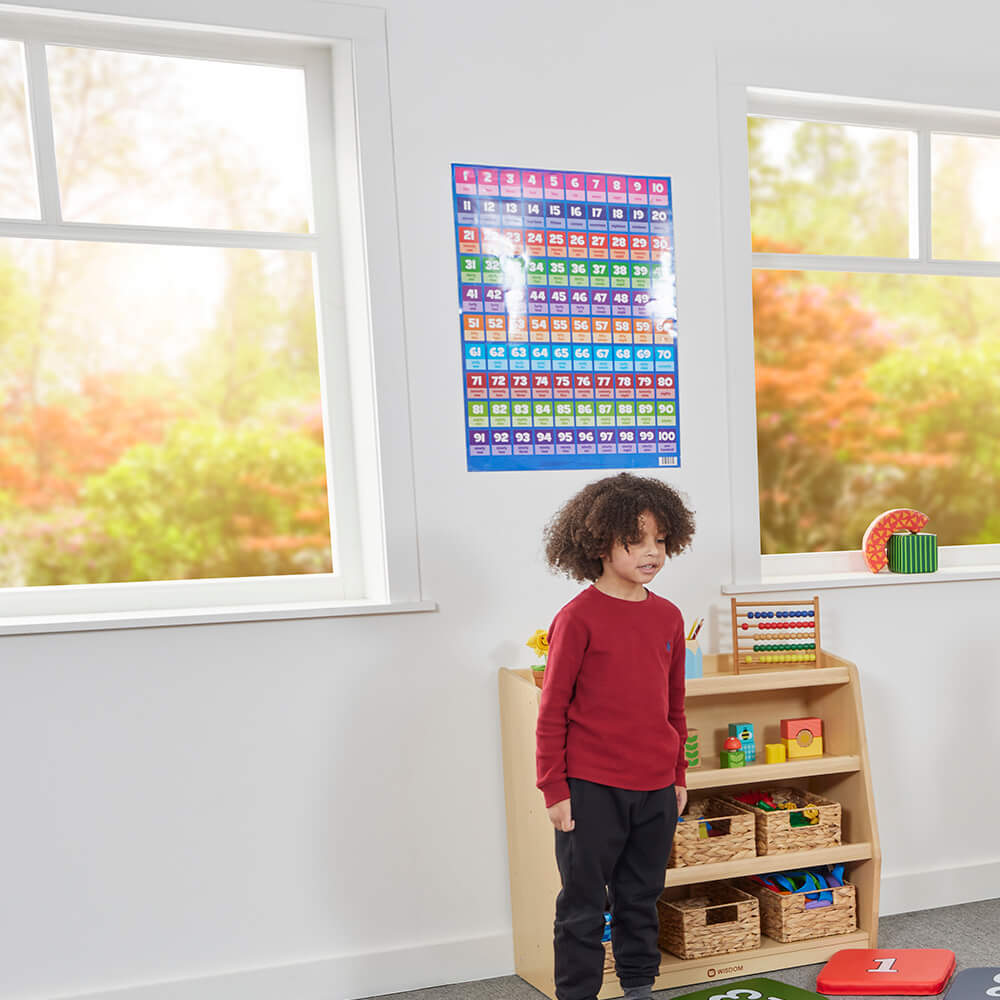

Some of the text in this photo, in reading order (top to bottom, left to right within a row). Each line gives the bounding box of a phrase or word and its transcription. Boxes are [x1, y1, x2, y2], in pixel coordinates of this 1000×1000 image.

[463, 200, 668, 222] 11 14 15 16 17 18 19 20
[463, 229, 647, 248] 21 24 25 26 27 28 29
[465, 259, 649, 276] 31 34 35 36 37 38 39
[466, 289, 649, 304] 41 42 44 45 46 47 48 49
[595, 320, 651, 332] 57 58 59
[469, 346, 672, 360] 61 62 63 64 65 66 67 68 69 70
[471, 375, 673, 387] 71 72 73 74 75 76 77 78 79 80
[658, 404, 674, 414] 90
[473, 431, 676, 443] 91 92 93 94 95 96 97 98 99 100
[717, 965, 744, 975] WISDOM
[866, 957, 898, 974] 1
